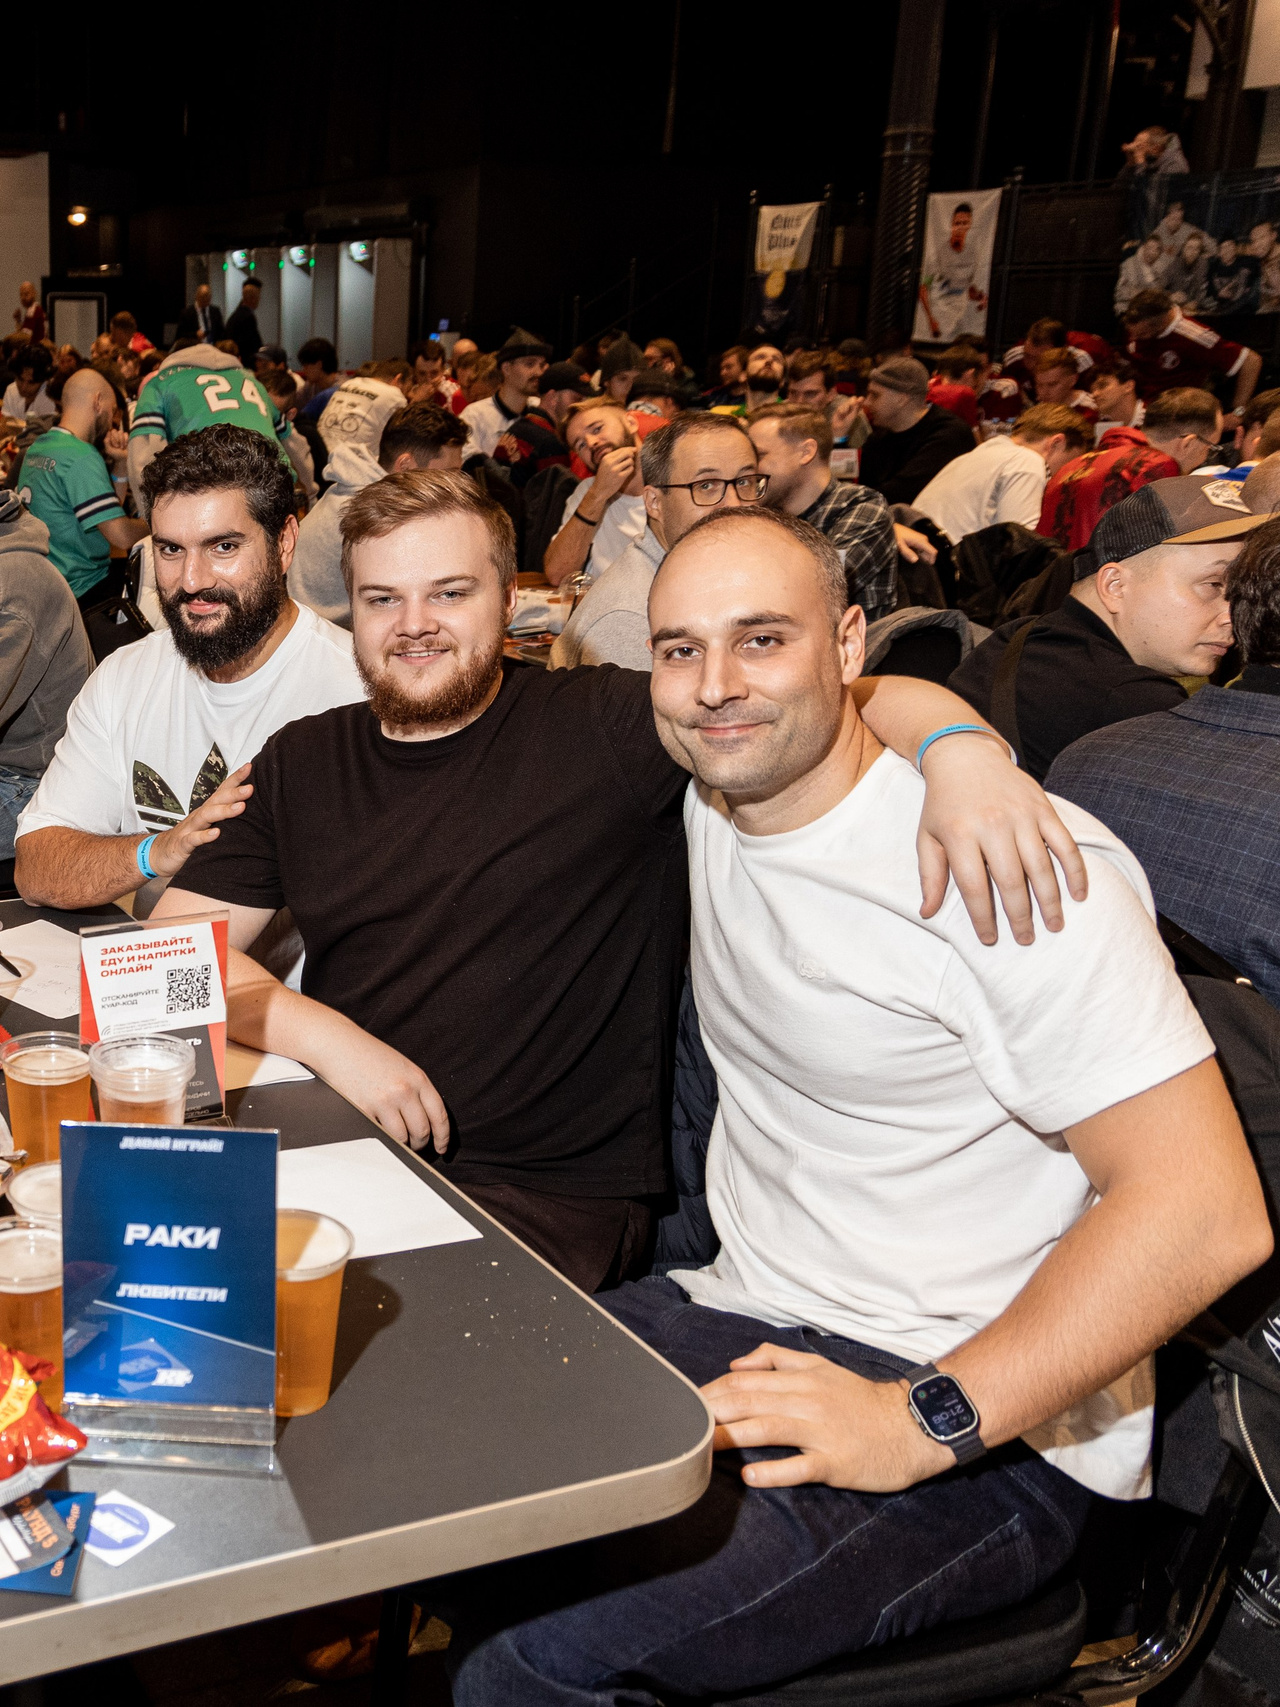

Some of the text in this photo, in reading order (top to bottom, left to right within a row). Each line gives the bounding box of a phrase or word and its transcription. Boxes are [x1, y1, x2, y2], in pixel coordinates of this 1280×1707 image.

[195, 374, 268, 417] 24
[100, 936, 193, 956] ЗАКАЗЫВАЙТЕ
[100, 957, 125, 967] ЕДУ
[137, 947, 196, 961] НАПИТКИ
[100, 963, 153, 978] ОНЛАЙН
[101, 988, 160, 1003] ОТСКАНИРУЙТЕ
[101, 999, 138, 1010] КУАР-КОД
[123, 1222, 221, 1250] РАКИ
[116, 1282, 228, 1303] ЛЮБИТЕЛИ
[931, 1403, 965, 1424] 21:08
